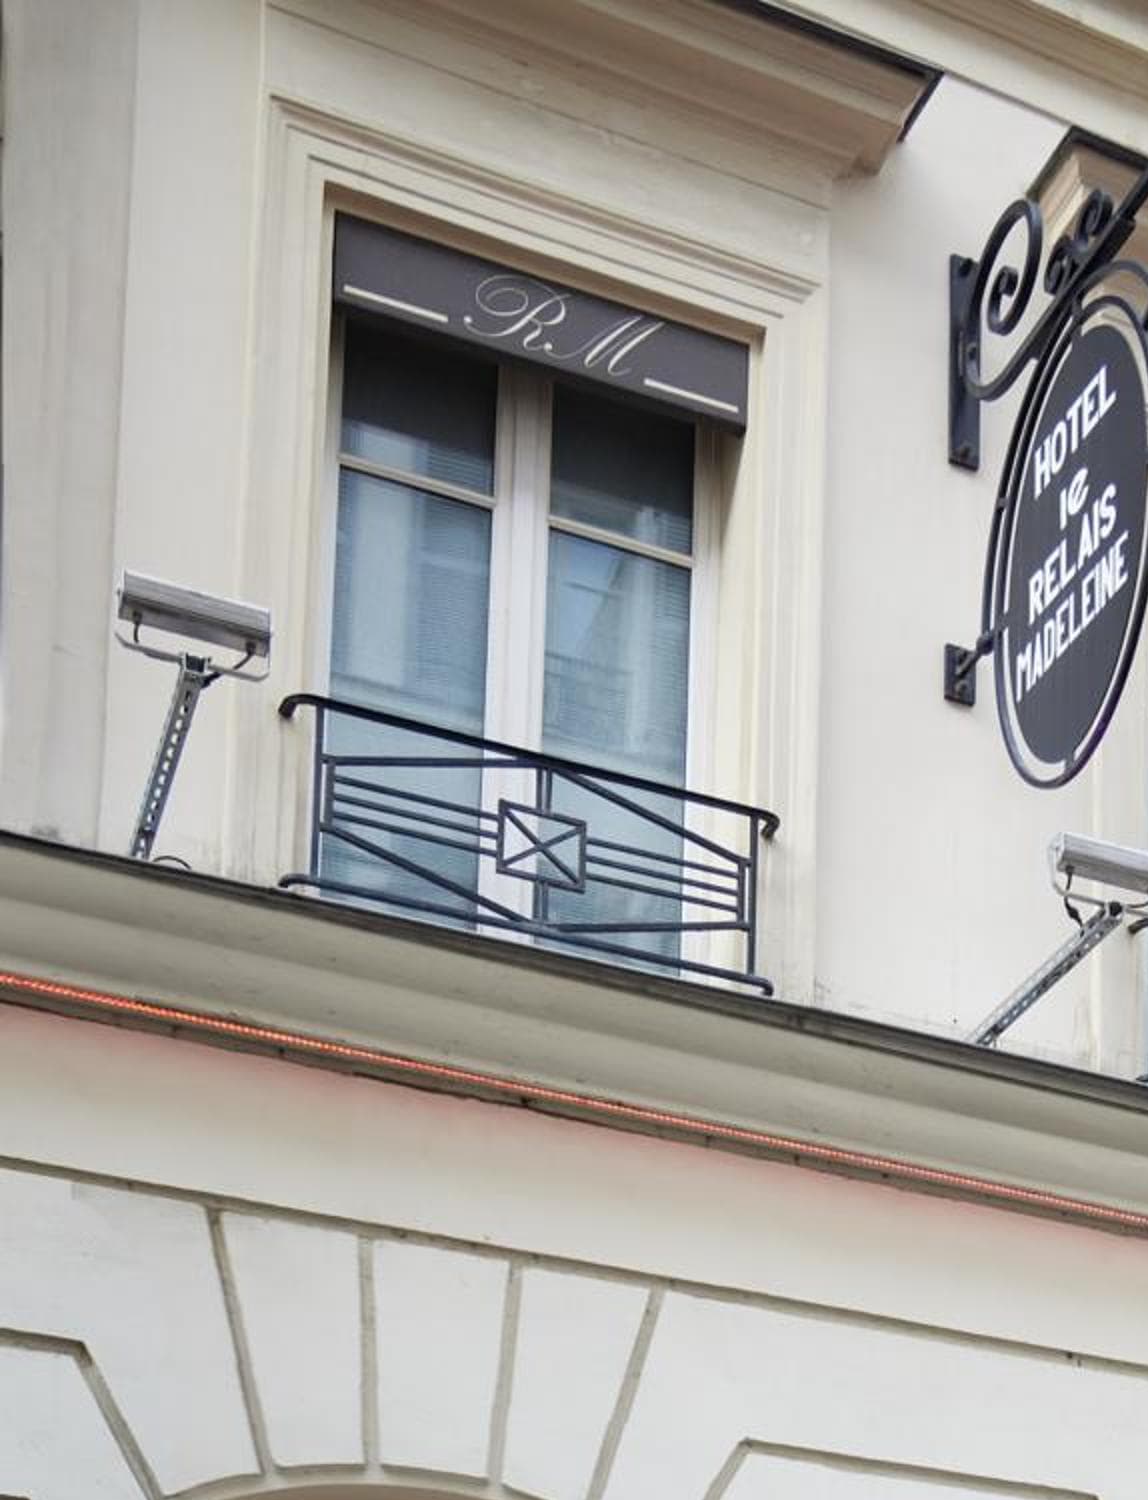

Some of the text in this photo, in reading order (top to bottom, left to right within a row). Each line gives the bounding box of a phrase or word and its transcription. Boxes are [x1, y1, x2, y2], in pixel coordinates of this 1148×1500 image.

[1033, 364, 1117, 500] HOTEL
[1059, 466, 1089, 530] le
[1015, 530, 1129, 703] MADELEINE
[1028, 483, 1117, 625] RELAIS
